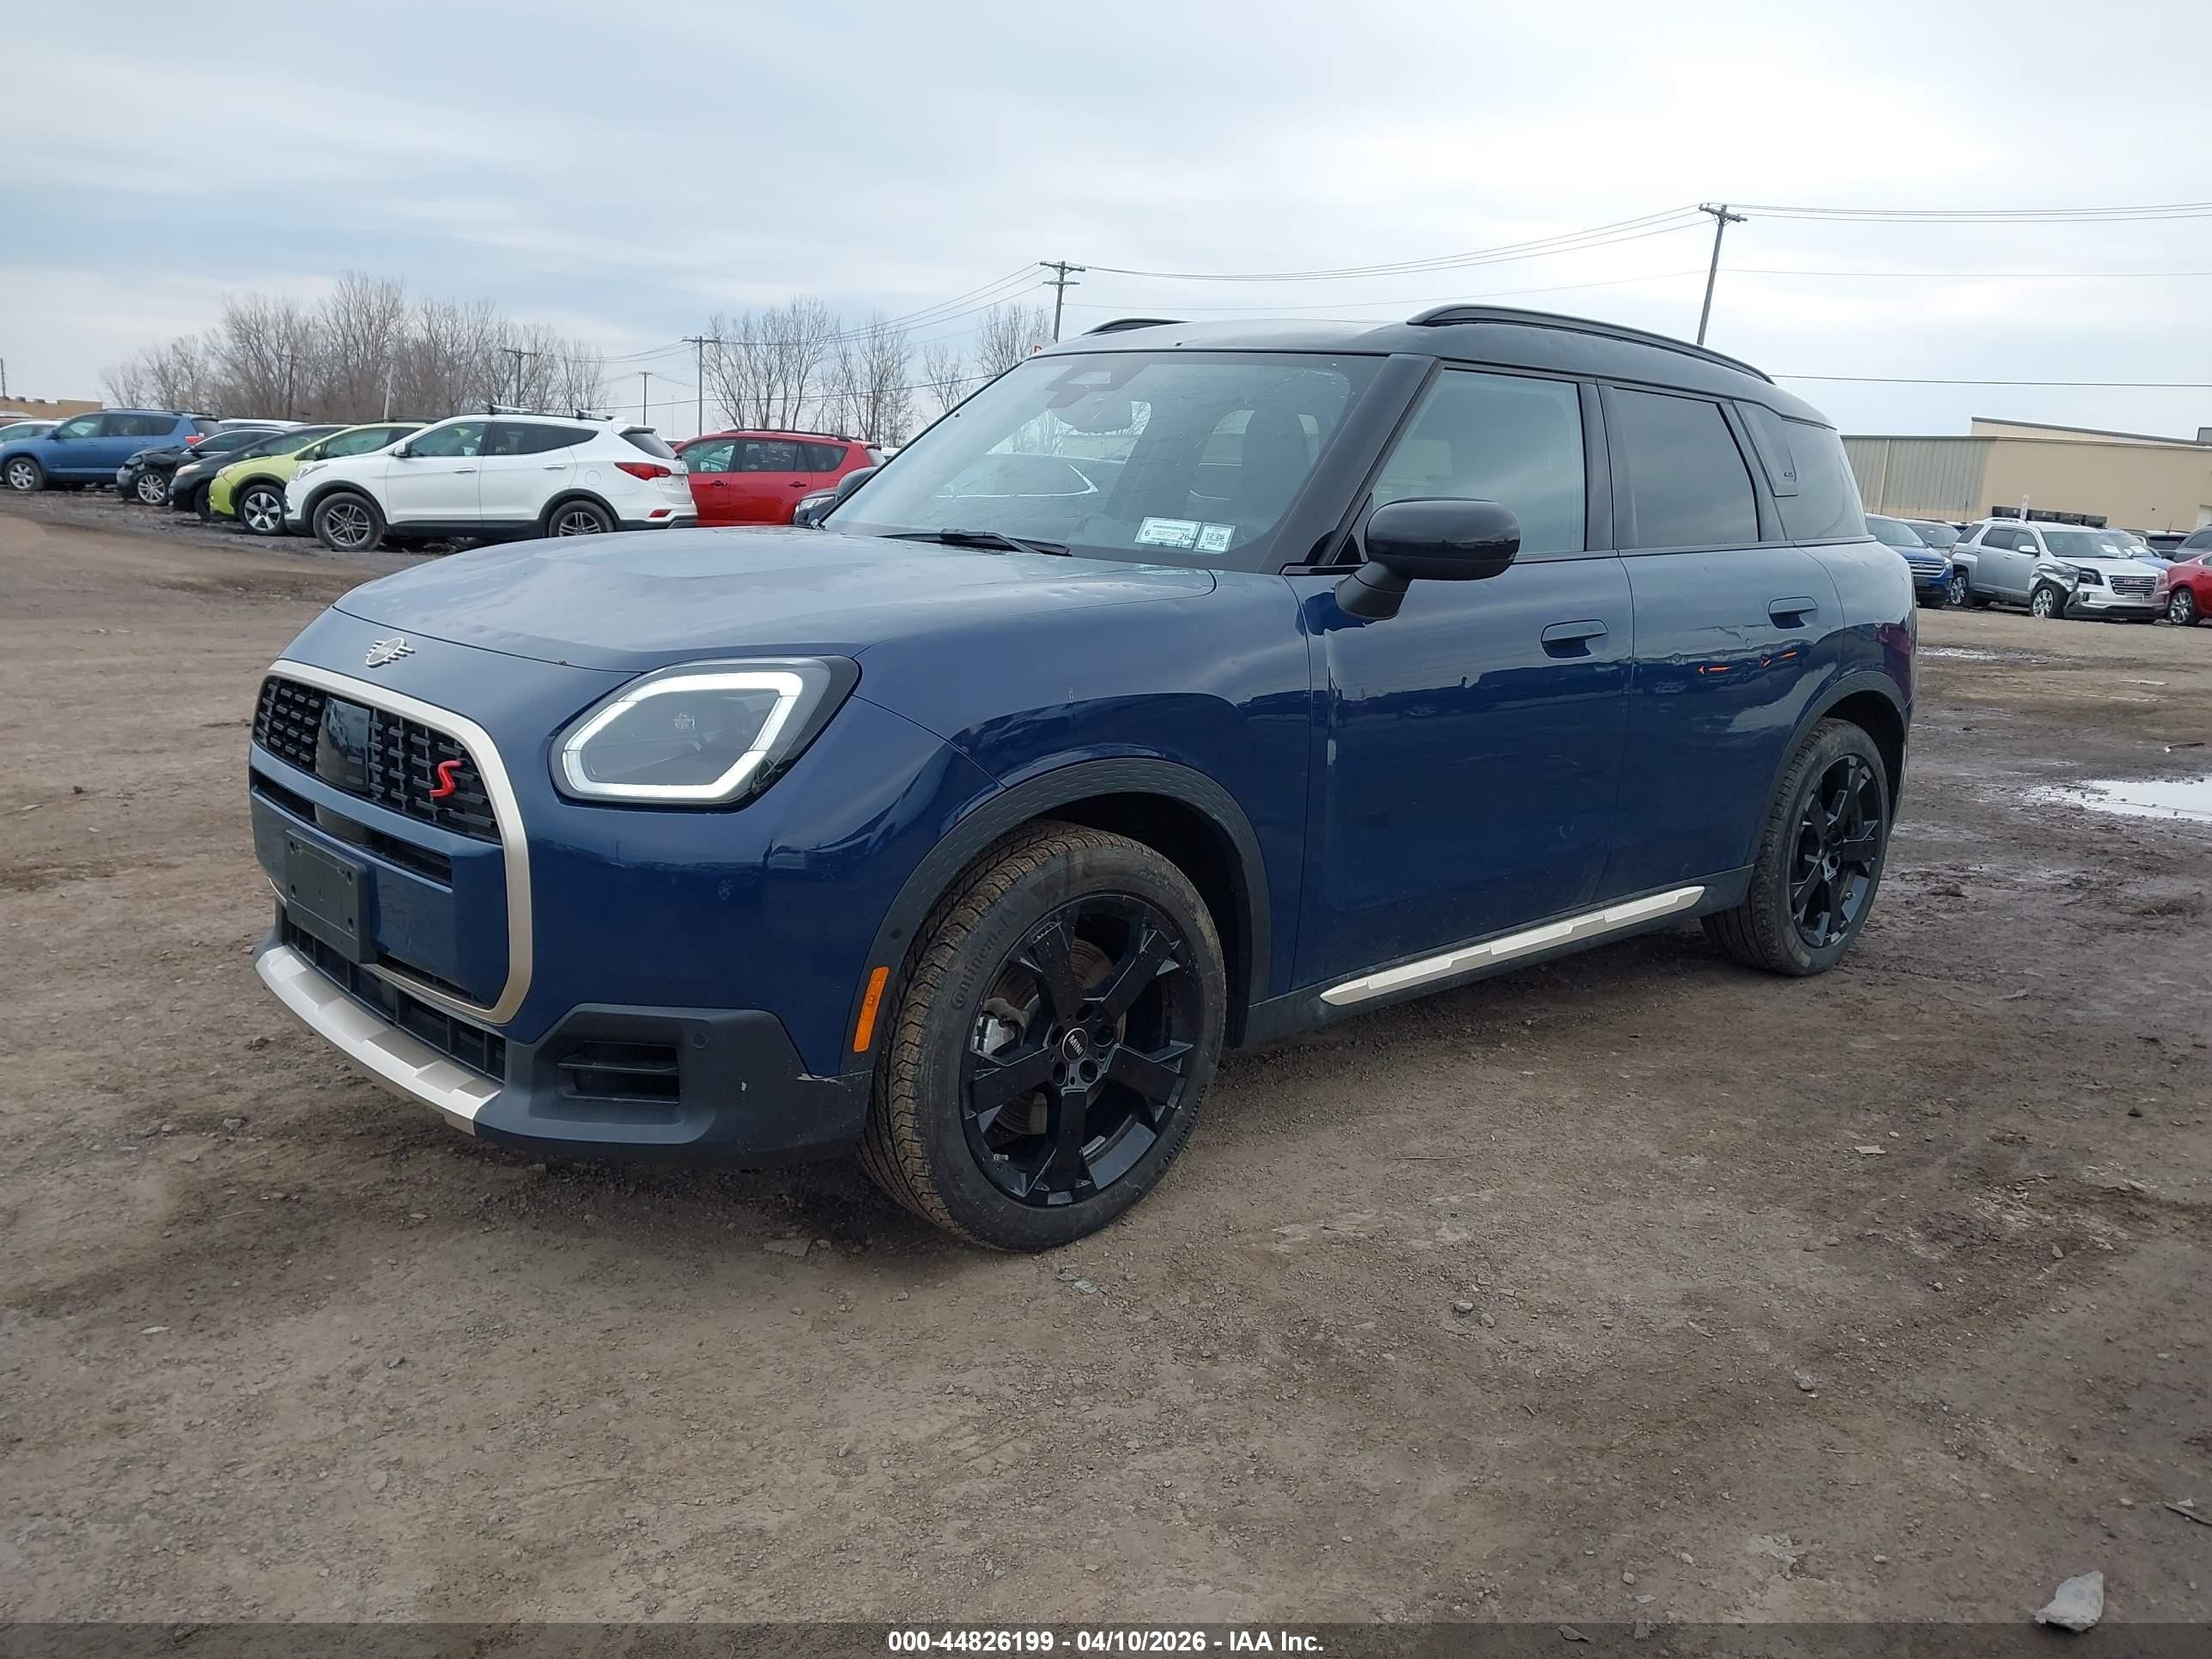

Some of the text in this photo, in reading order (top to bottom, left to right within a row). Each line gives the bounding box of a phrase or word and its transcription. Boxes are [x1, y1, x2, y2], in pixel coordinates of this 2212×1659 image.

[1178, 532, 1190, 541] 26
[428, 760, 462, 798] S
[1067, 1034, 1085, 1056] MINI
